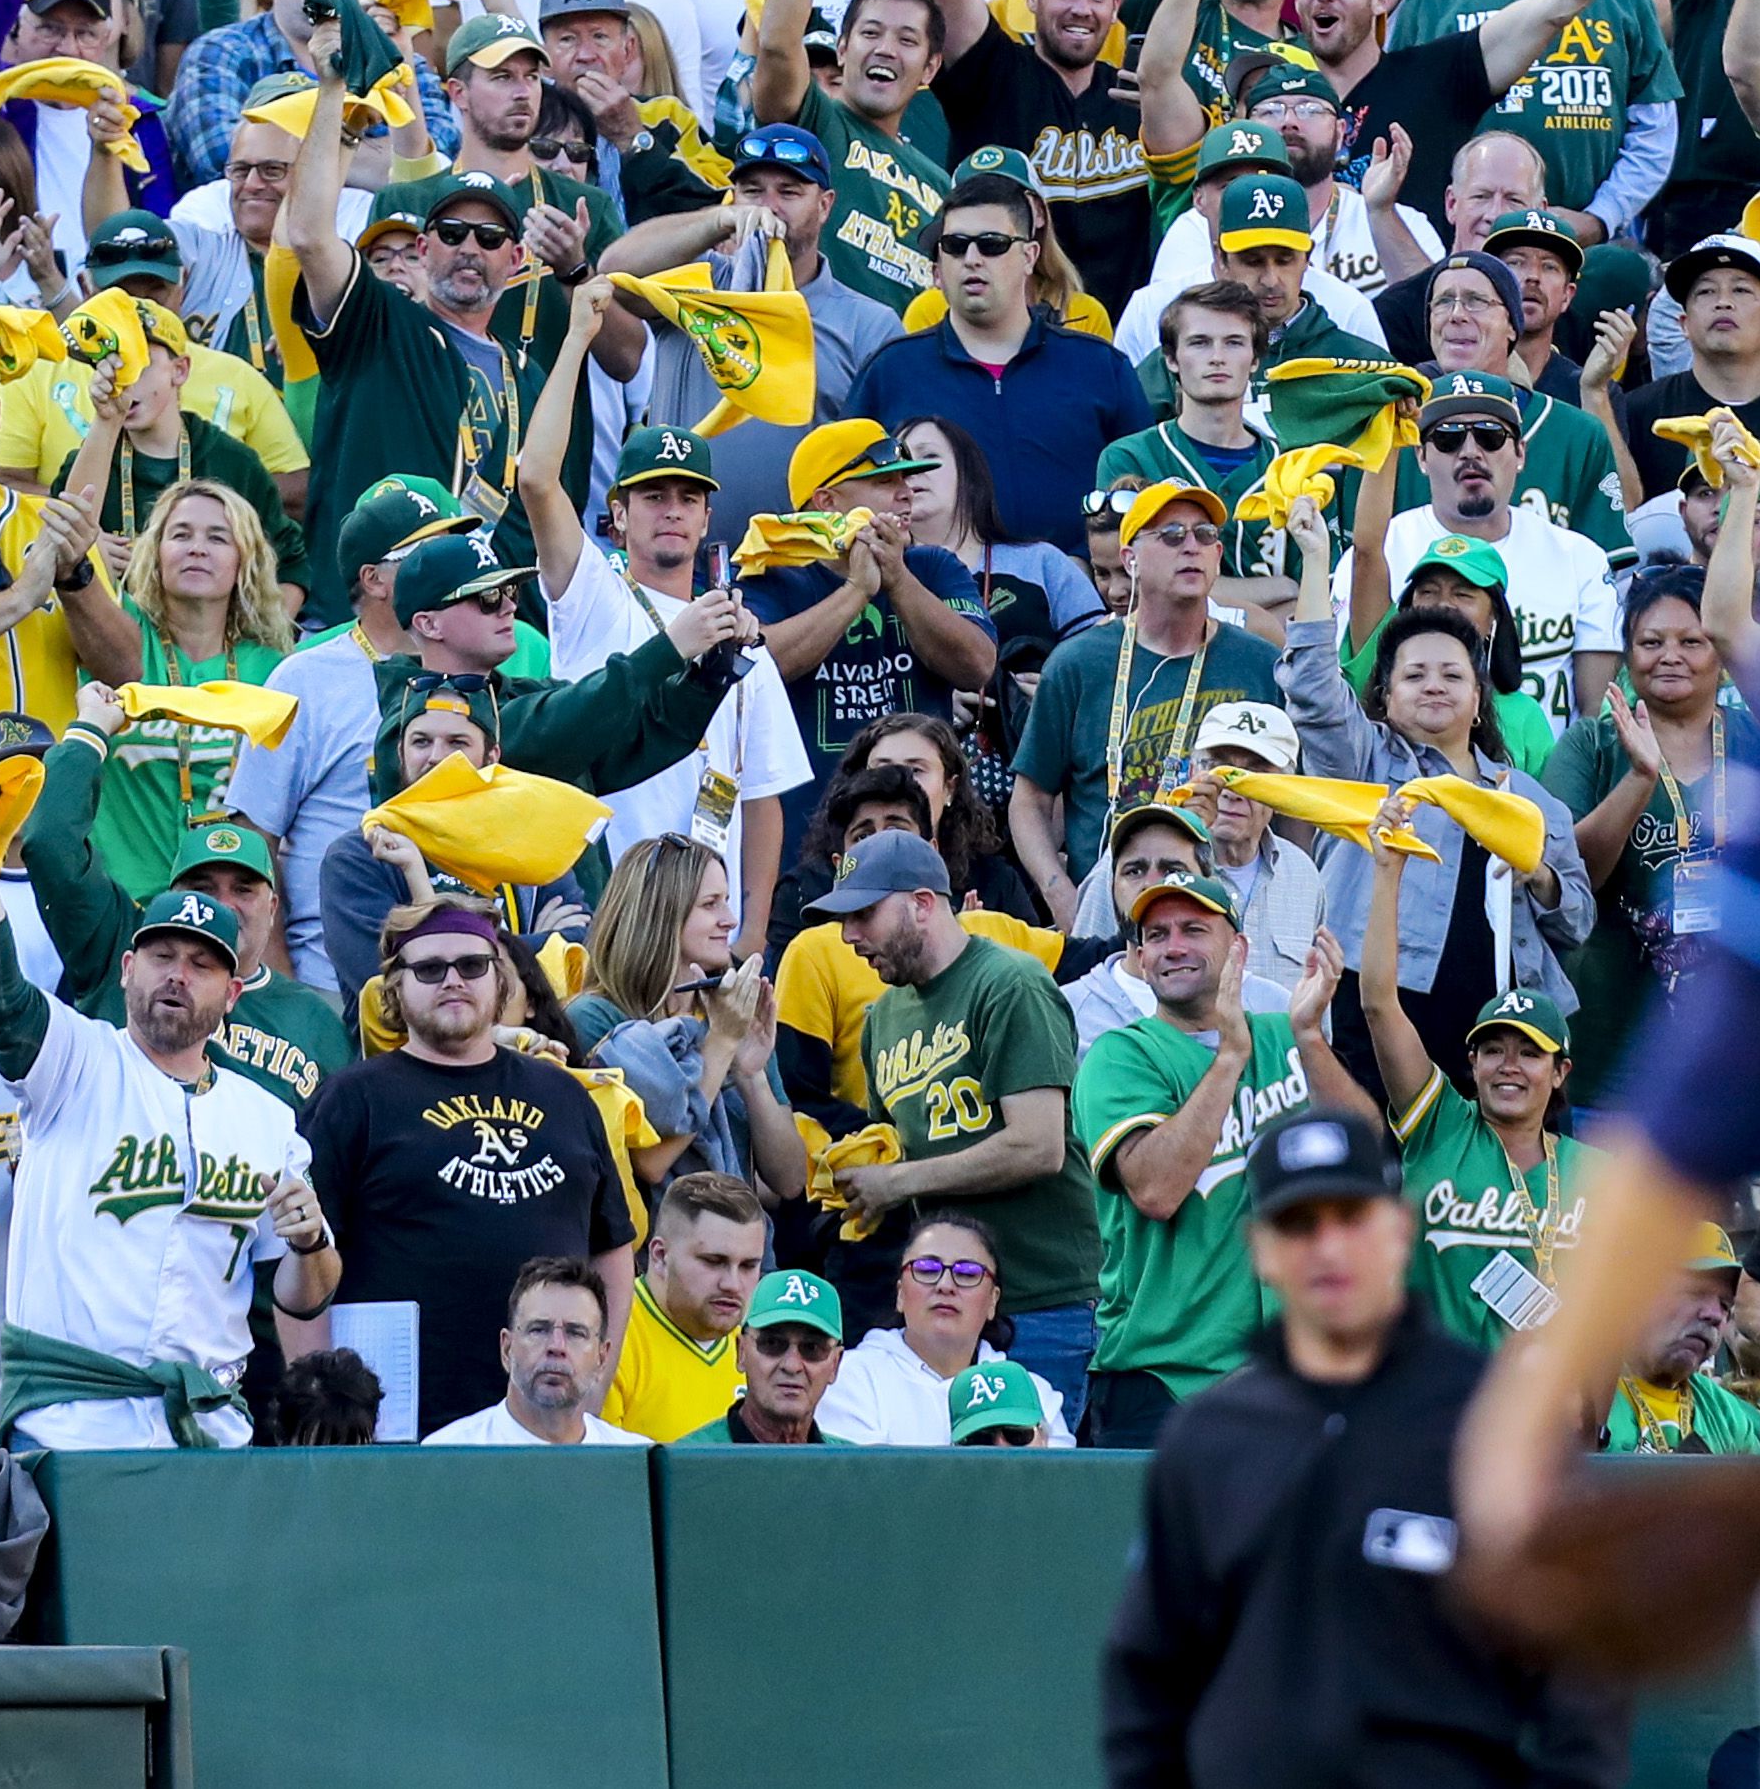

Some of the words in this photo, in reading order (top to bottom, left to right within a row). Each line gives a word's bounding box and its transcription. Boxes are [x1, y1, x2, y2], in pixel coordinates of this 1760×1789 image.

[1542, 72, 1614, 106] 2013
[1544, 115, 1612, 130] ATHLETICS
[1032, 125, 1147, 199] Athletic
[423, 1095, 544, 1130] OAKLAND
[927, 1076, 994, 1141] 20
[438, 1155, 567, 1197] ATHLETICS
